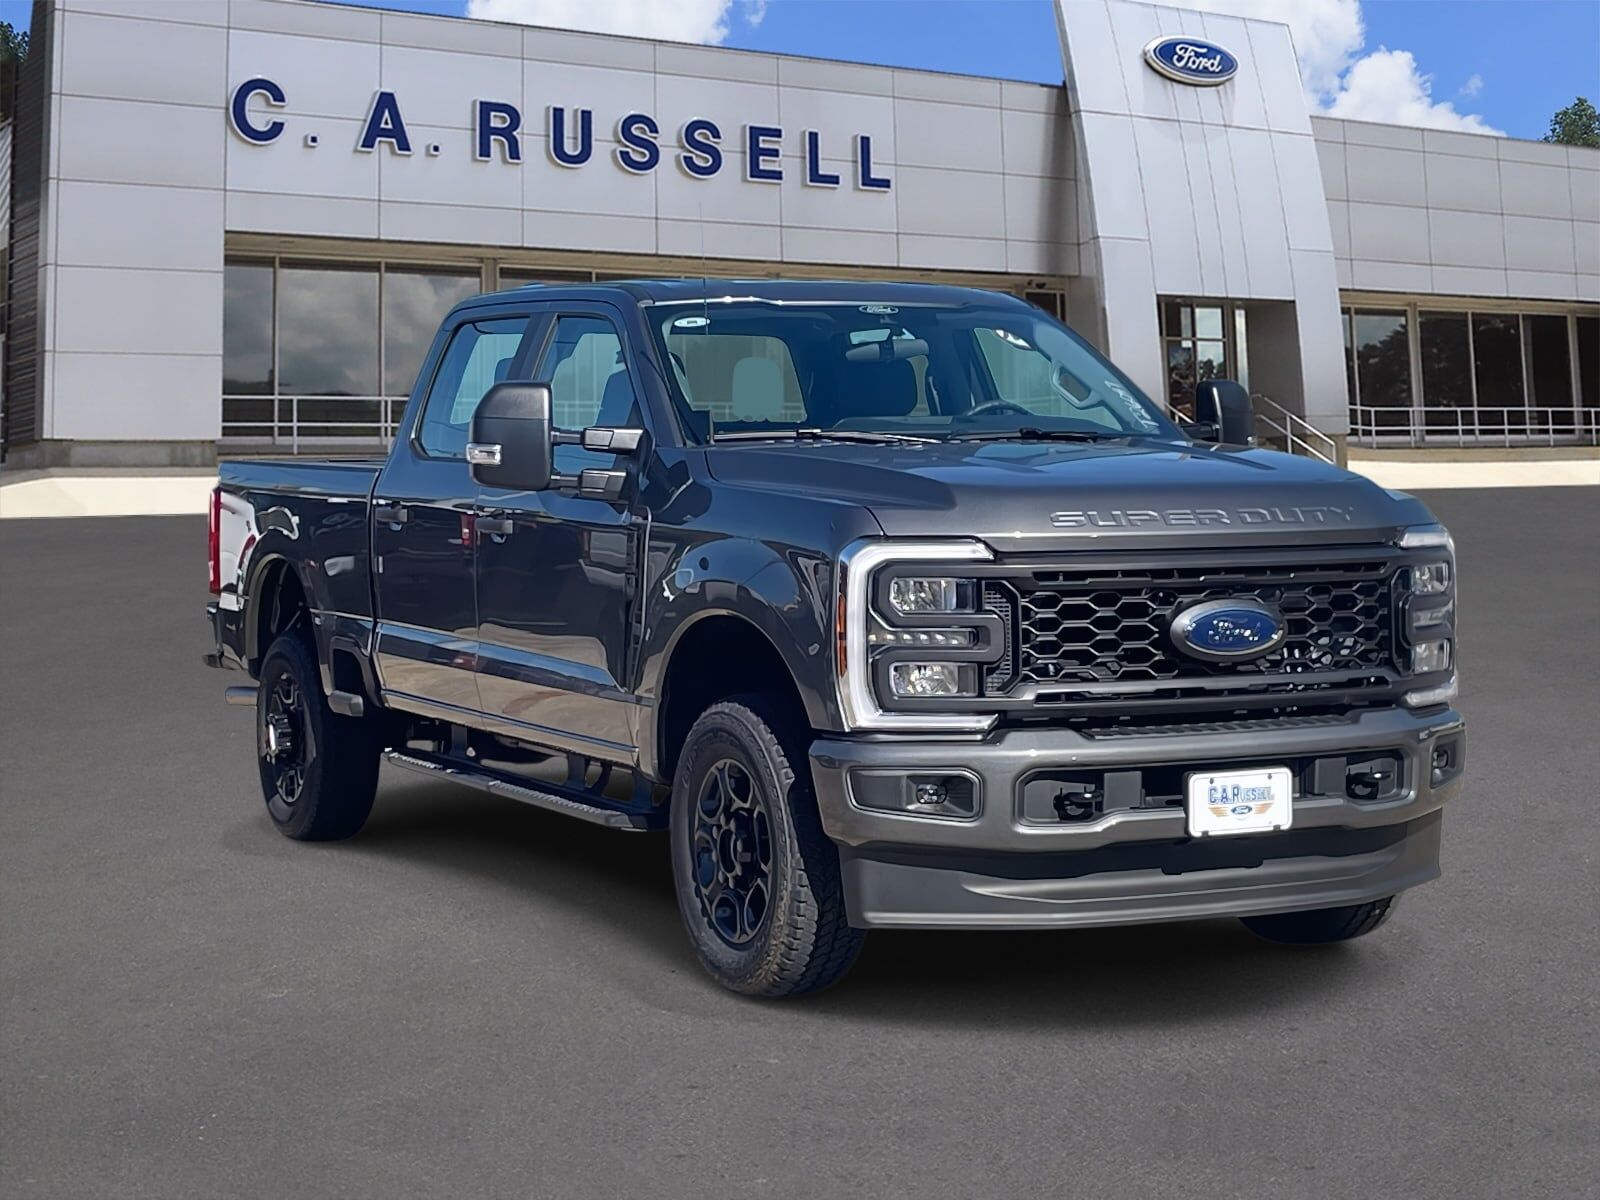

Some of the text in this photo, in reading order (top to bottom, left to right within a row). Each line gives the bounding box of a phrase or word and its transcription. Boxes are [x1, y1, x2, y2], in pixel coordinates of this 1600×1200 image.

[1172, 43, 1222, 73] Ford
[473, 98, 892, 192] RUSSELL
[1050, 506, 1354, 528] SUPER DUTY
